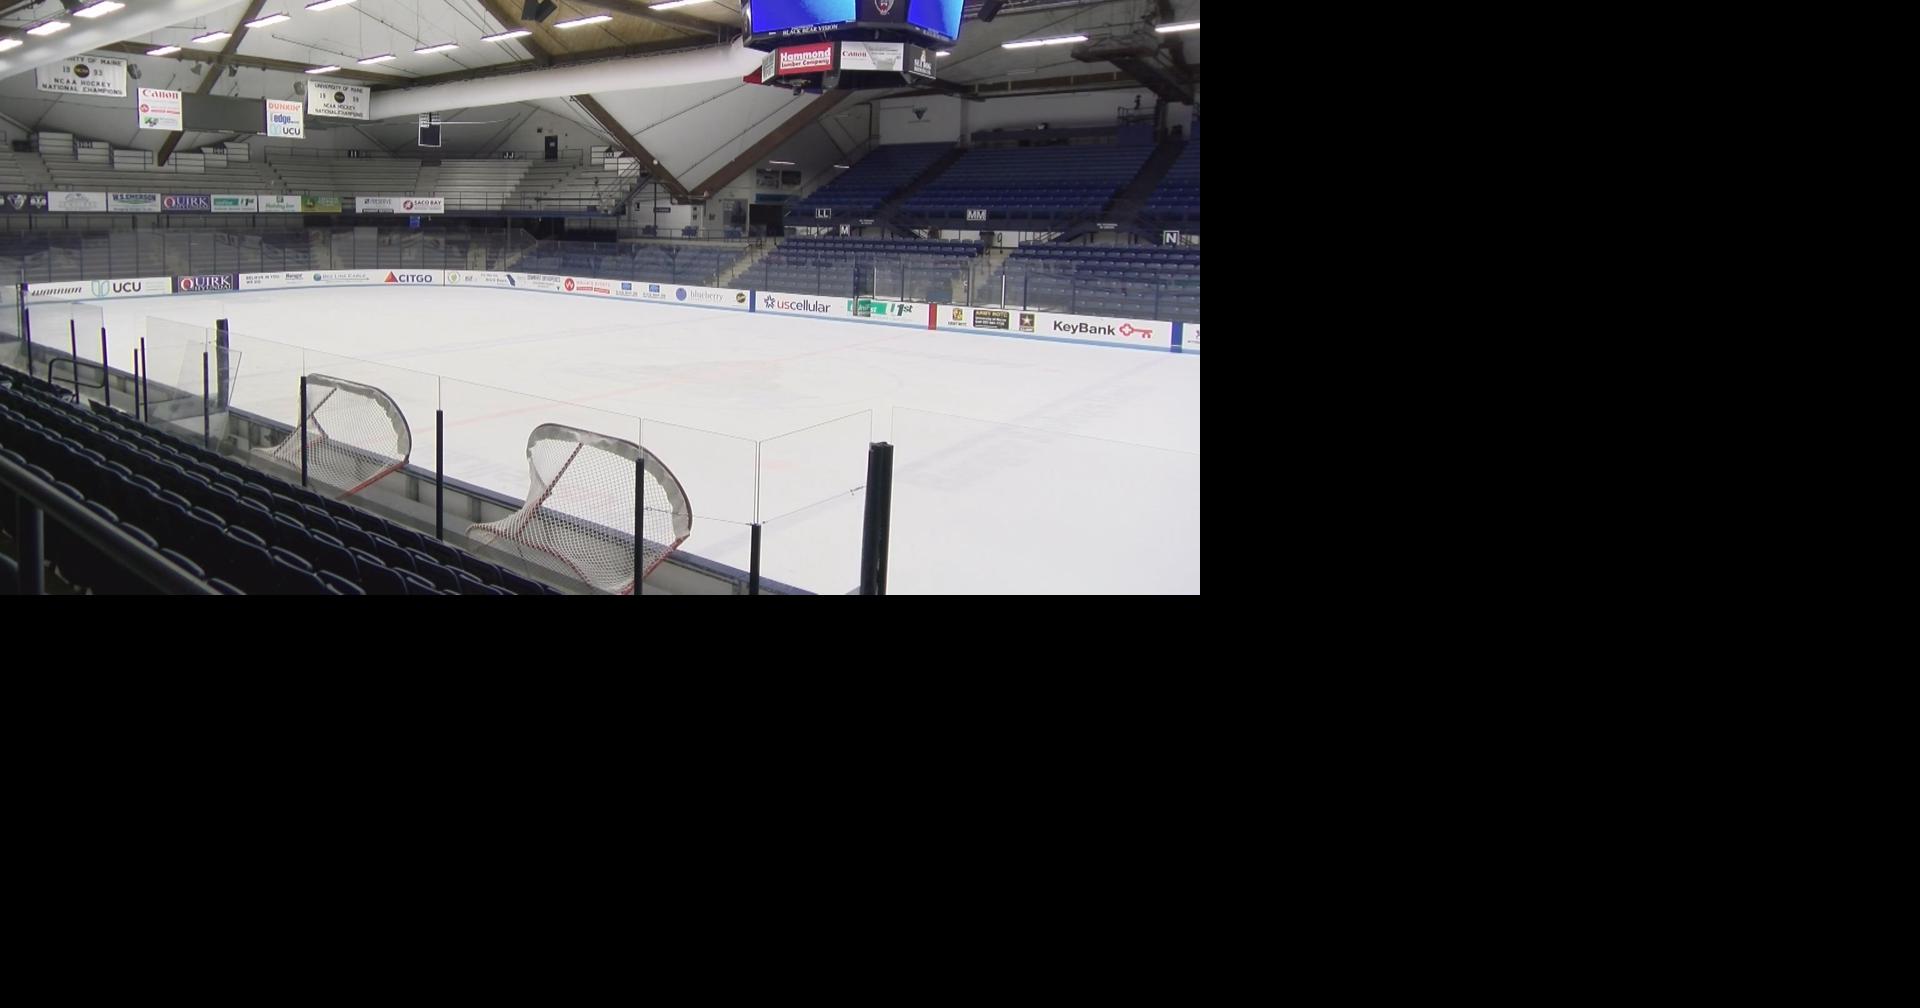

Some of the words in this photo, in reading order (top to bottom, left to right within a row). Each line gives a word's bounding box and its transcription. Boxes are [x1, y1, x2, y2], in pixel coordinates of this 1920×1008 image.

[780, 47, 832, 61] Hammond
[42, 83, 78, 91] NATIONAL
[82, 86, 123, 95] CHAMPIONS
[142, 89, 179, 99] Canon
[282, 127, 301, 135] UCU
[163, 195, 208, 208] QUIRK
[1166, 232, 1177, 244] N
[180, 275, 230, 290] QUIRK
[398, 274, 433, 283] CITGO
[112, 281, 142, 293] UCU
[776, 300, 832, 313] uscellular
[1053, 320, 1116, 335] KeyBank
